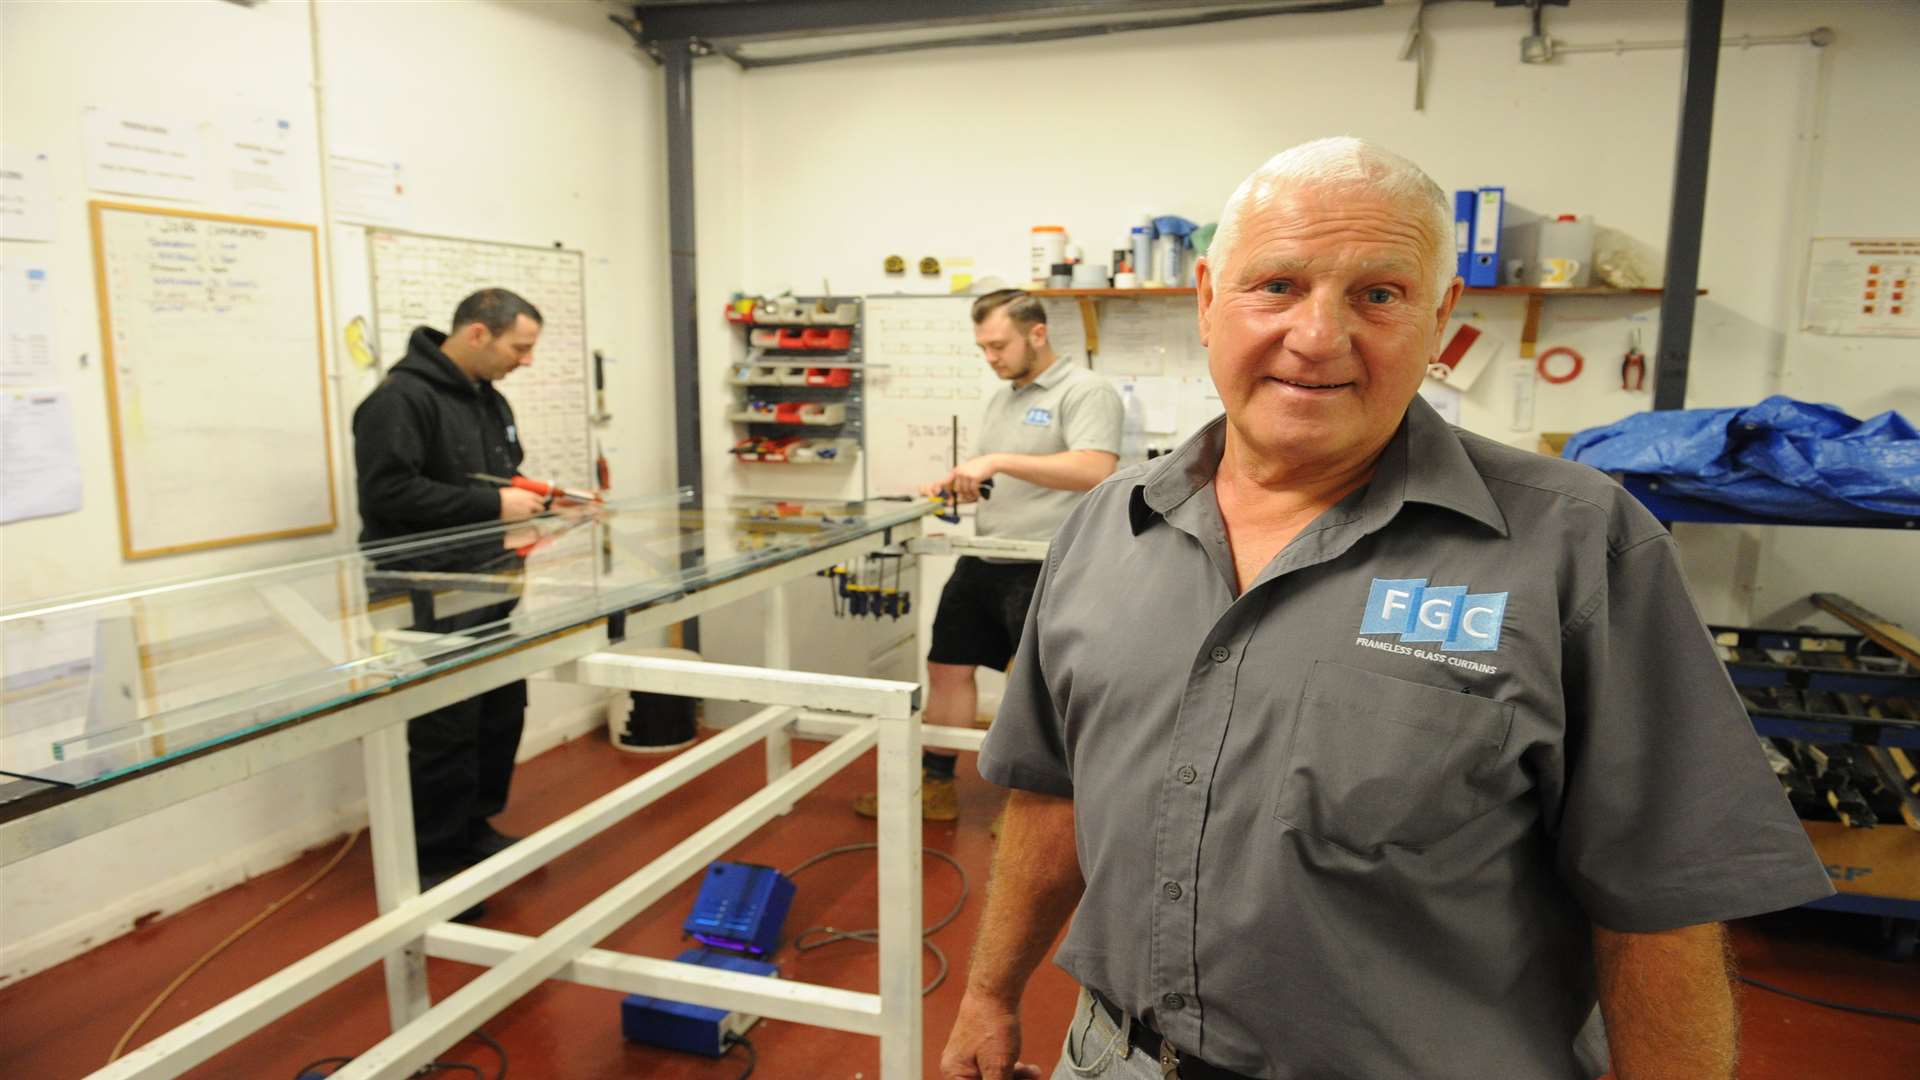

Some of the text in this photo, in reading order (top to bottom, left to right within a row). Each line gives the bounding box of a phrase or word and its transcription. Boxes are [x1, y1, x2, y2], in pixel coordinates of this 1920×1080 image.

[1382, 589, 1494, 638] FGC
[1356, 637, 1497, 675] FRAMELESS GLASS CURTAINS
